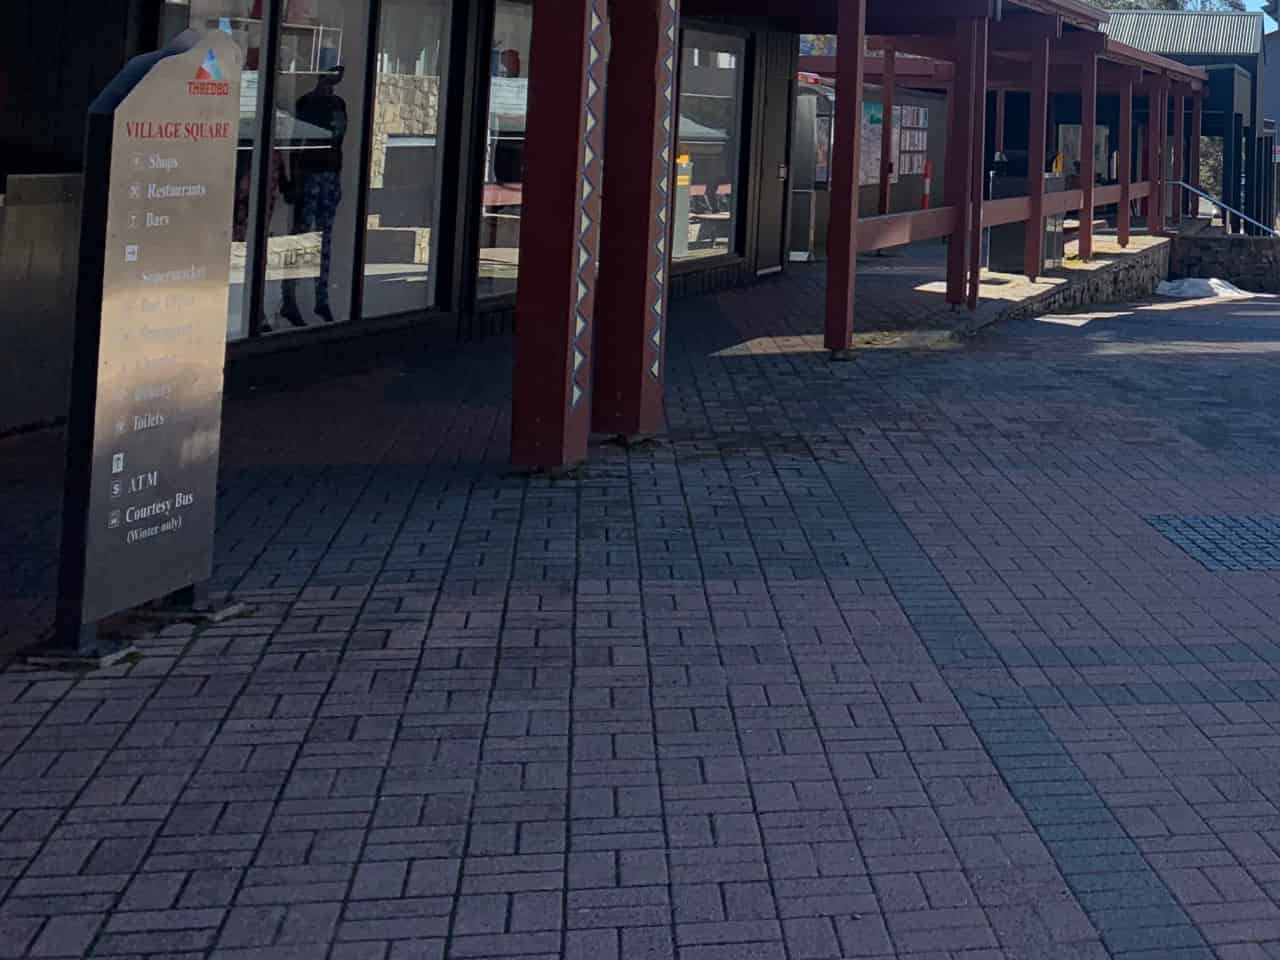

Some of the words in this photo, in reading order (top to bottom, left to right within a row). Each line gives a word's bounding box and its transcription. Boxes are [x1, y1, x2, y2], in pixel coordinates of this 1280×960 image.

[187, 81, 231, 96] THREDBO
[126, 121, 181, 140] VILLAGE
[183, 122, 231, 142] SQUARE
[148, 153, 178, 172] Shops
[147, 183, 206, 198] Restaurants
[145, 212, 169, 228] Bars
[133, 411, 165, 431] Toilets
[127, 471, 158, 494] ATM
[126, 501, 171, 523] Courtesy
[175, 493, 193, 508] Bus
[127, 525, 159, 544] (Winter
[161, 516, 182, 535] only)
